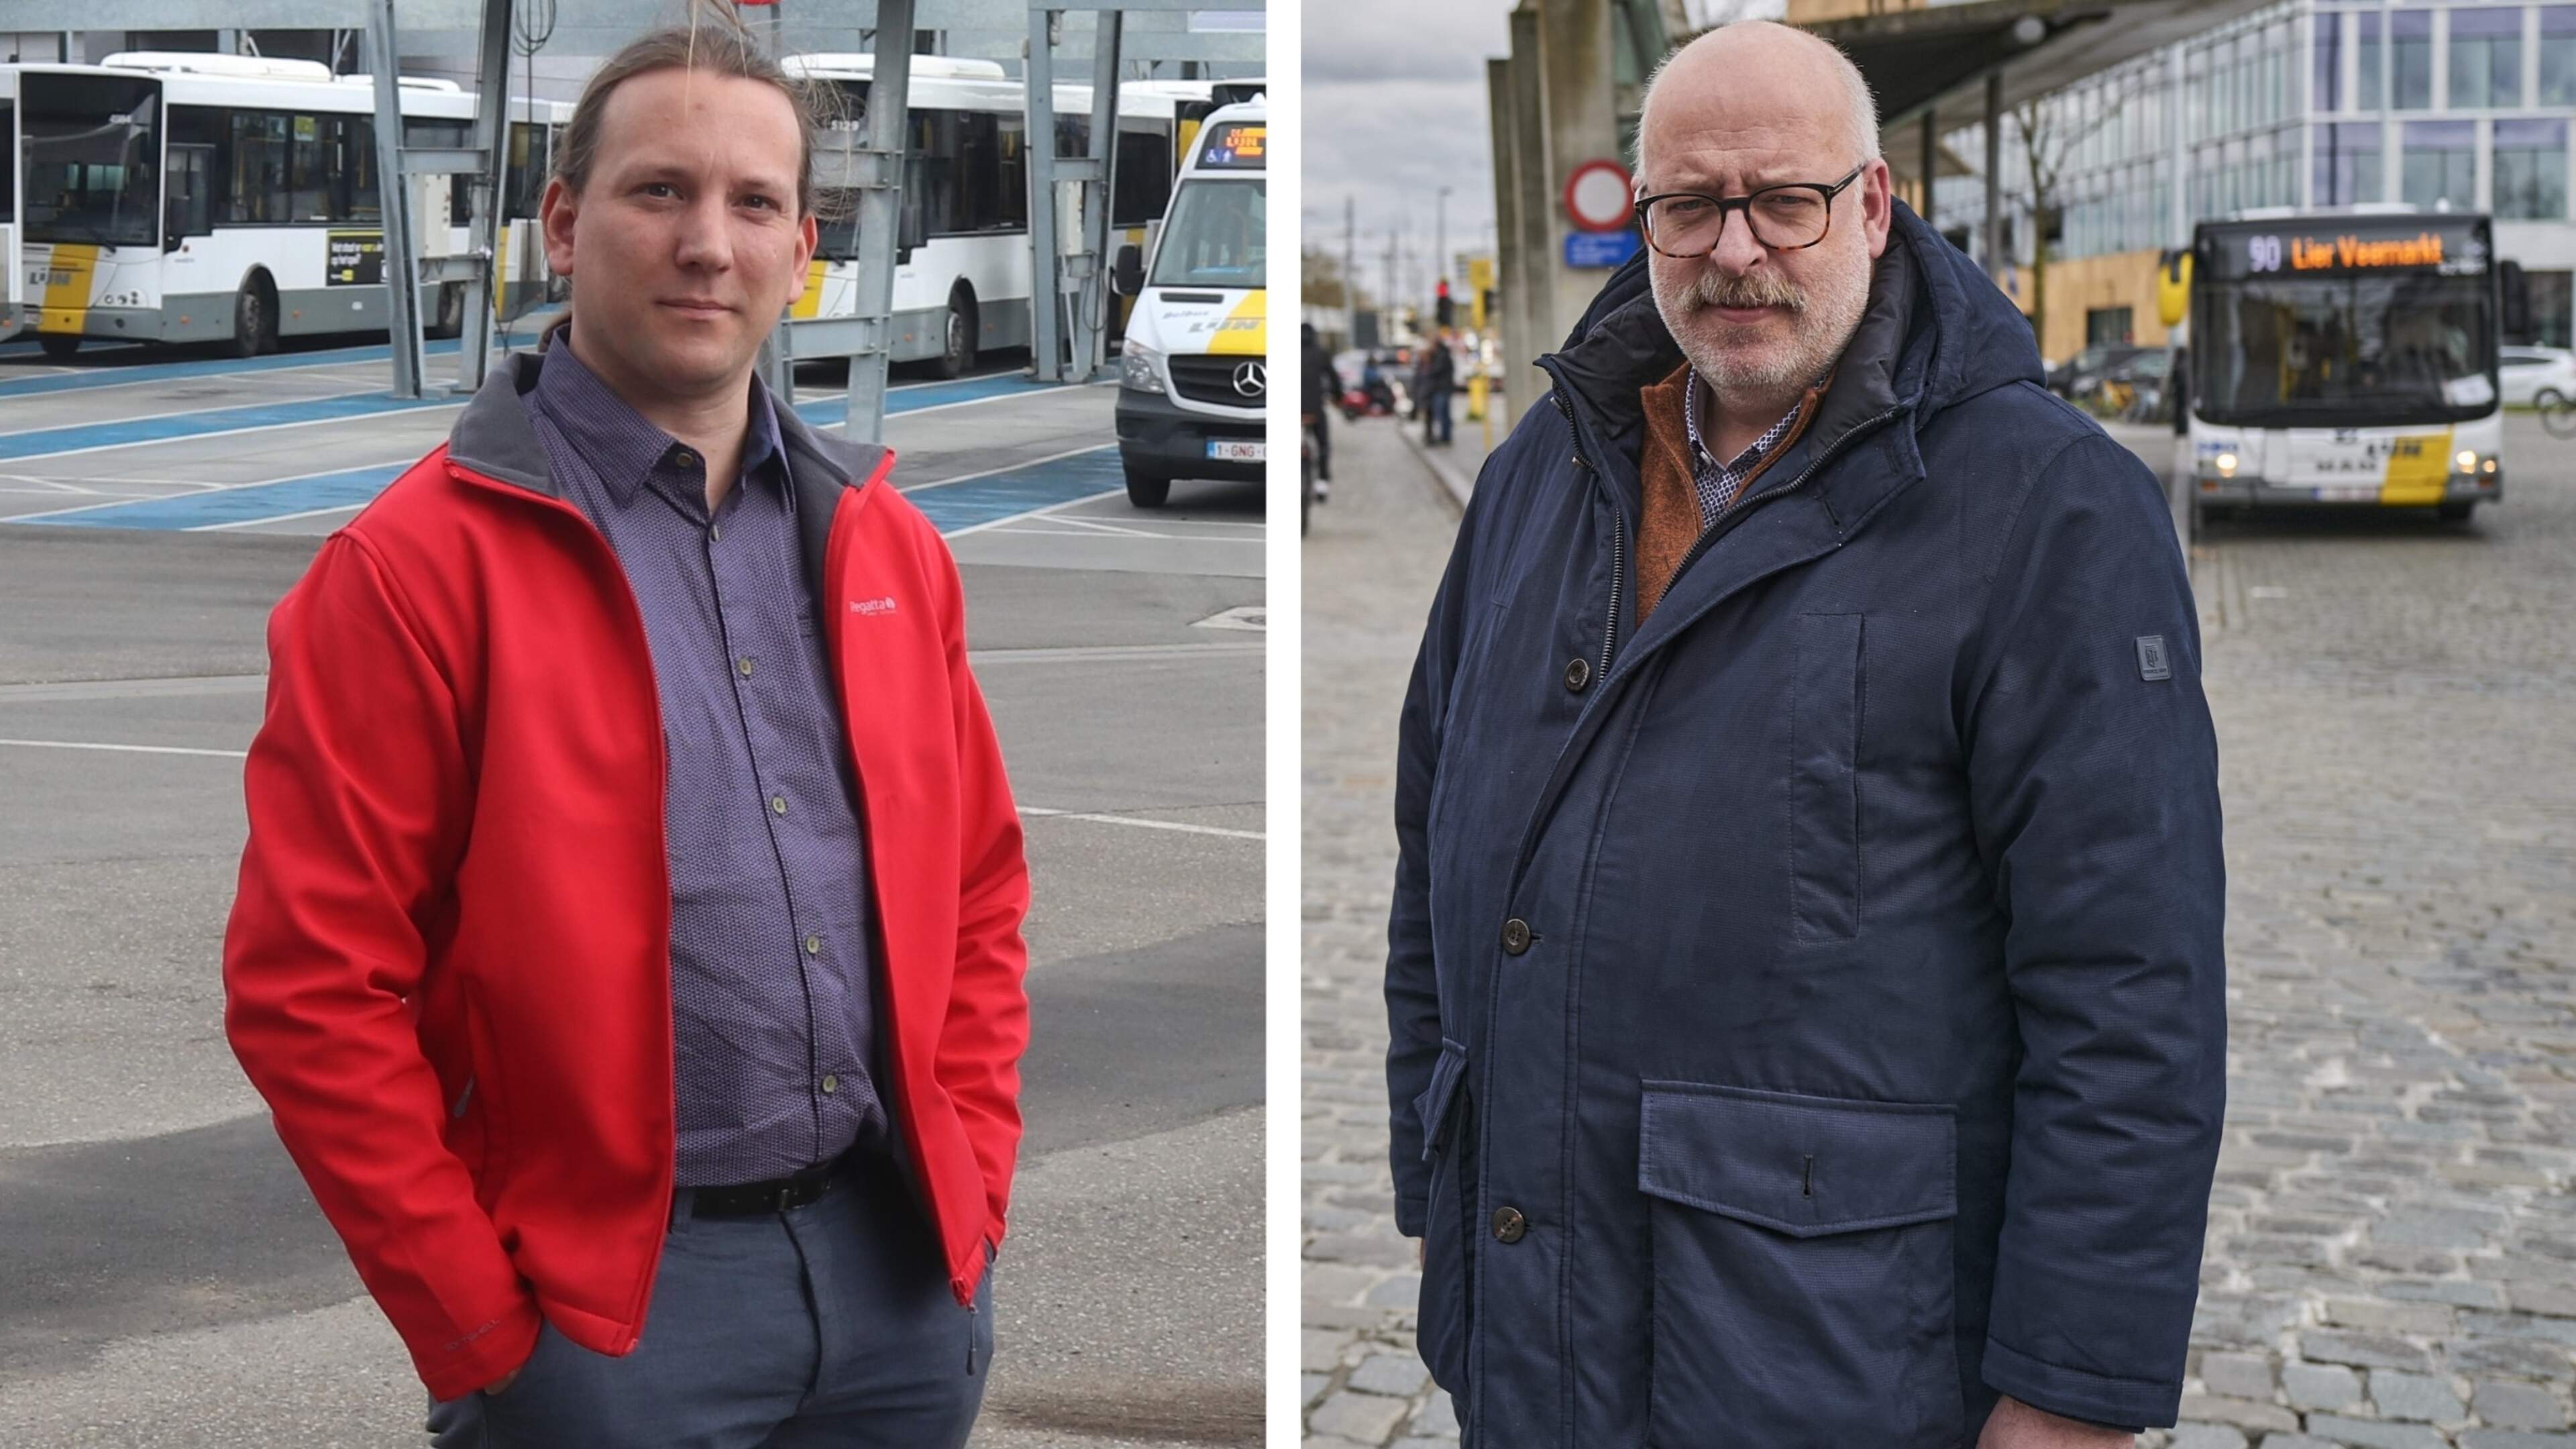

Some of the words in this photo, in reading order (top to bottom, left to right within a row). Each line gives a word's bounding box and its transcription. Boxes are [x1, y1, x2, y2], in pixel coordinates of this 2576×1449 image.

[2249, 235, 2281, 272] 90
[2291, 237, 2333, 269] Lier
[2337, 232, 2443, 268] Veemarkt
[849, 599, 885, 614] Regatta
